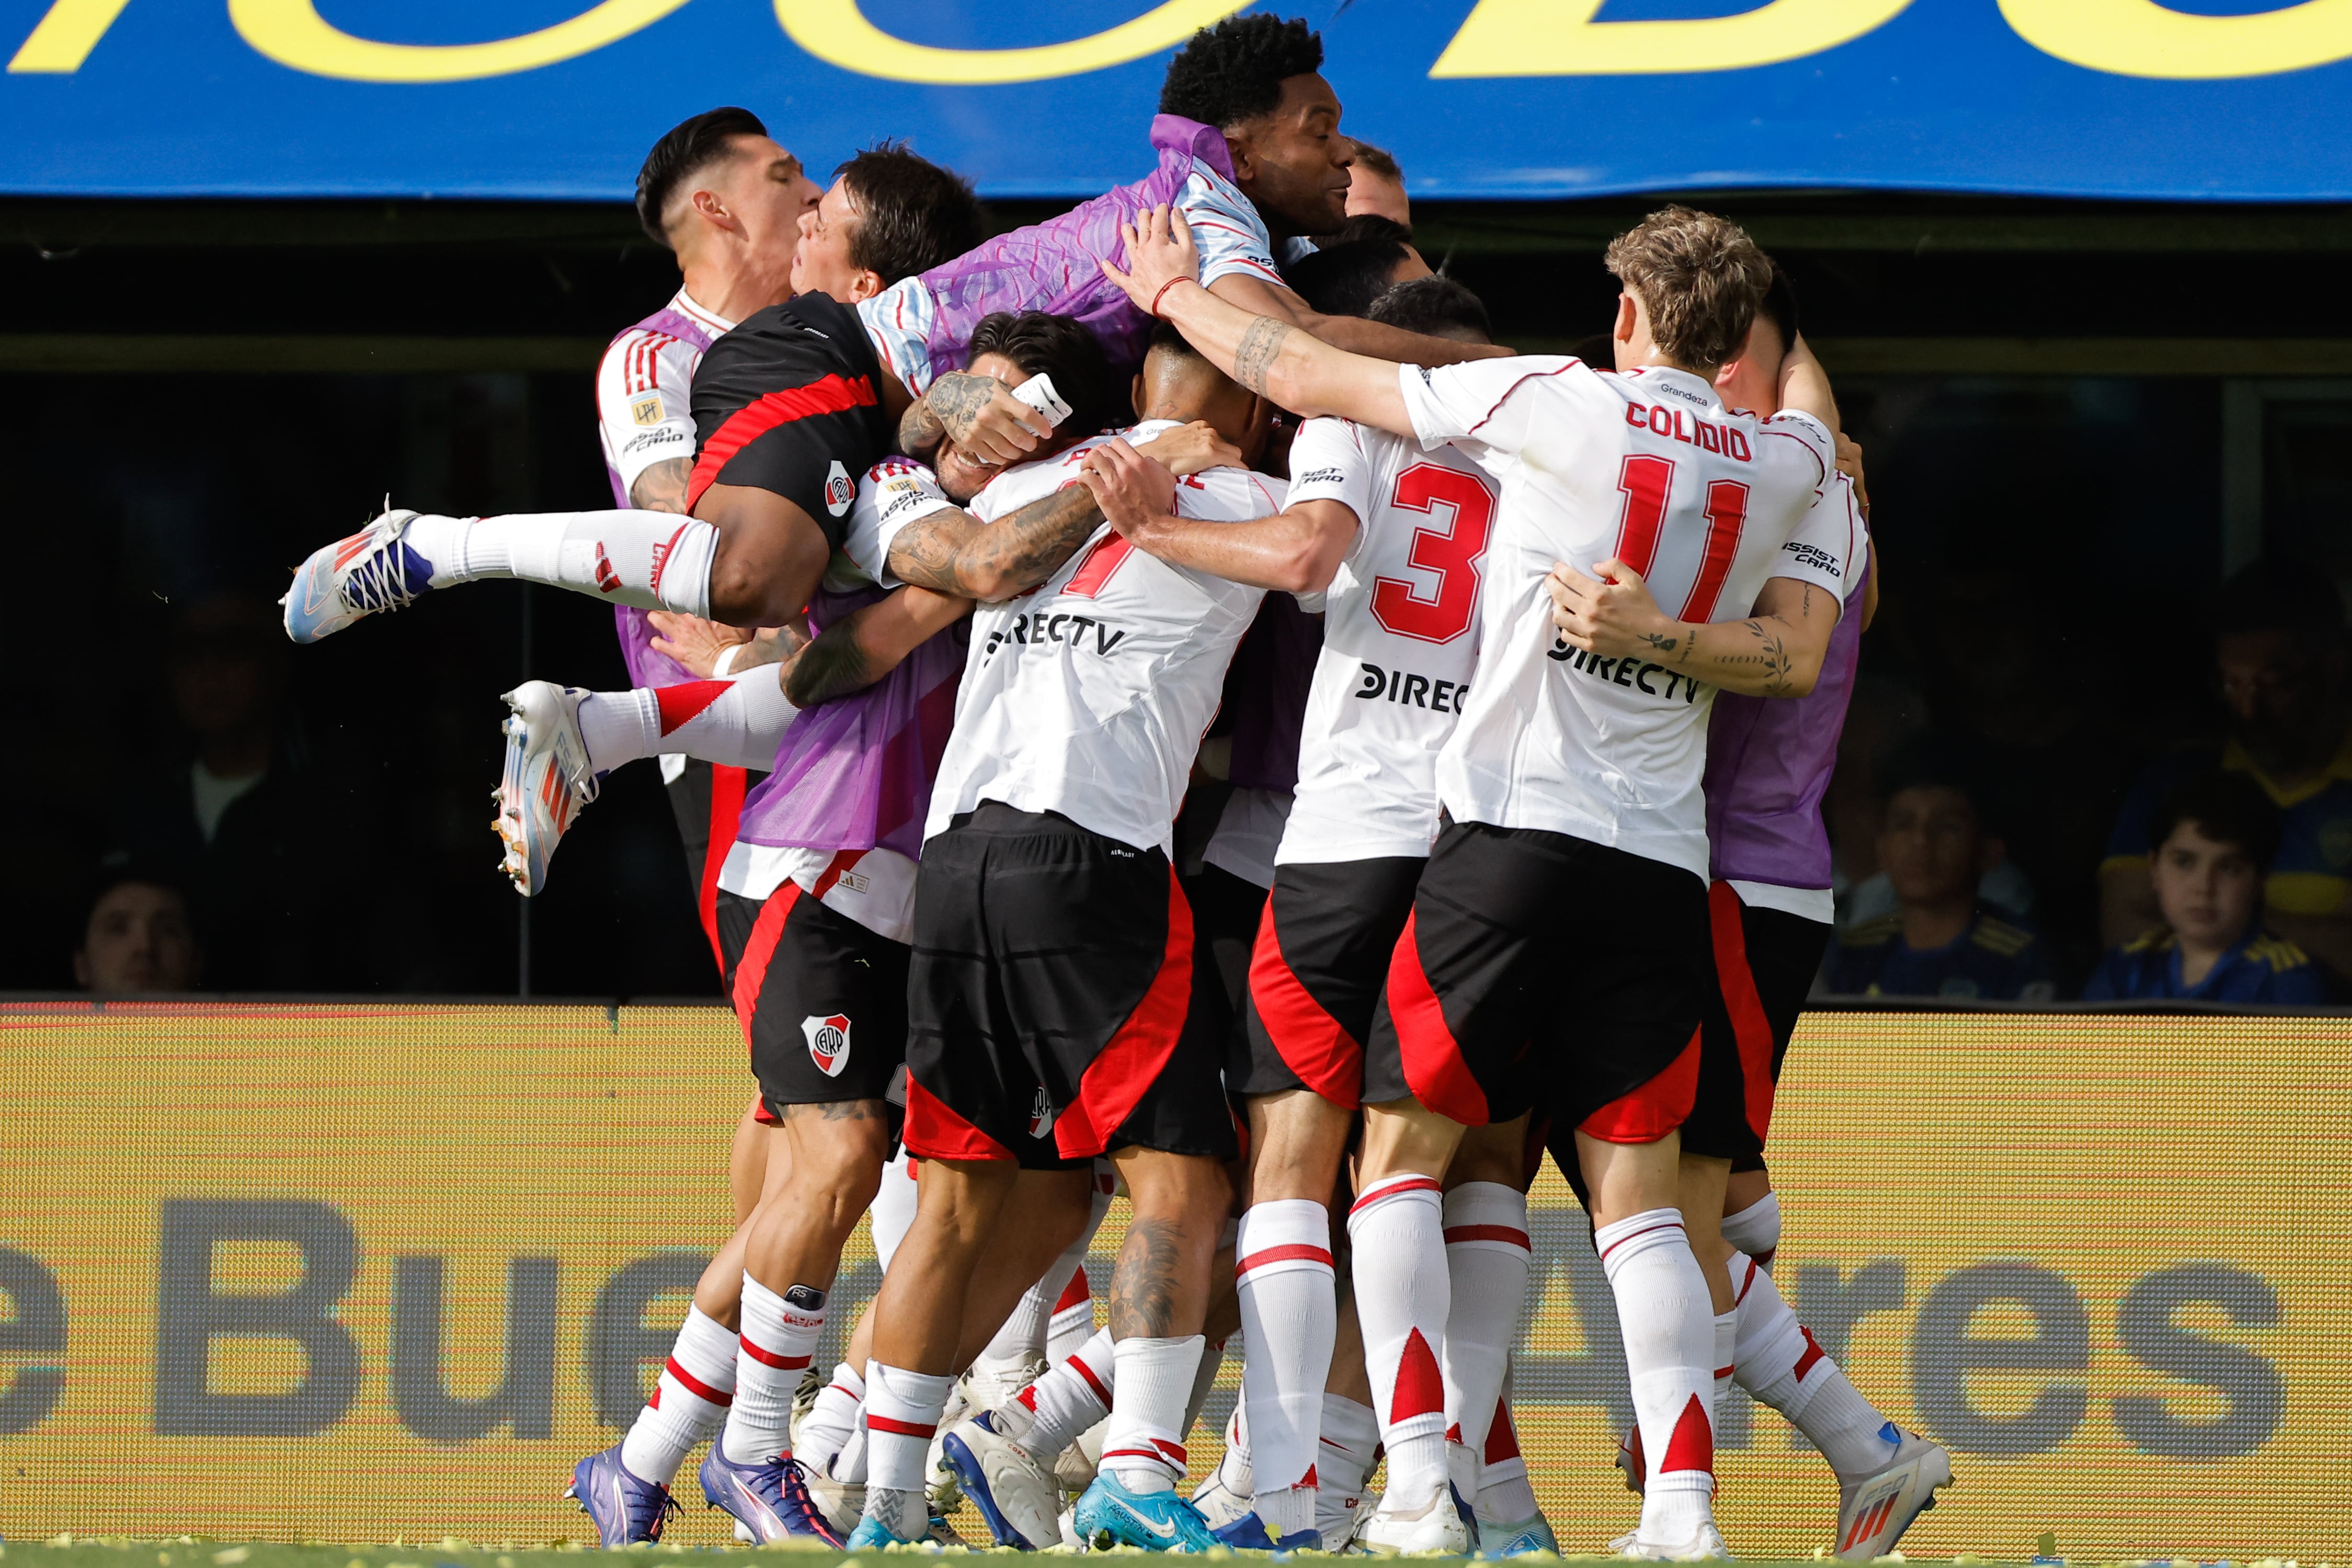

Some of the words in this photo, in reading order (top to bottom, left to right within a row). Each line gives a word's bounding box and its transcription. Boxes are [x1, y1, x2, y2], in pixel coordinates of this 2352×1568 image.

[1661, 384, 1708, 406] Grandeza
[1626, 401, 1752, 462] COLIDIO
[881, 490, 924, 521] ASSIS
[1369, 461, 1496, 645] 3
[1604, 454, 1751, 624] 11
[1795, 554, 1841, 578] CARD
[1355, 663, 1469, 716] DIREC
[792, 1288, 808, 1298] RS
[1008, 1444, 1025, 1459] COPA
